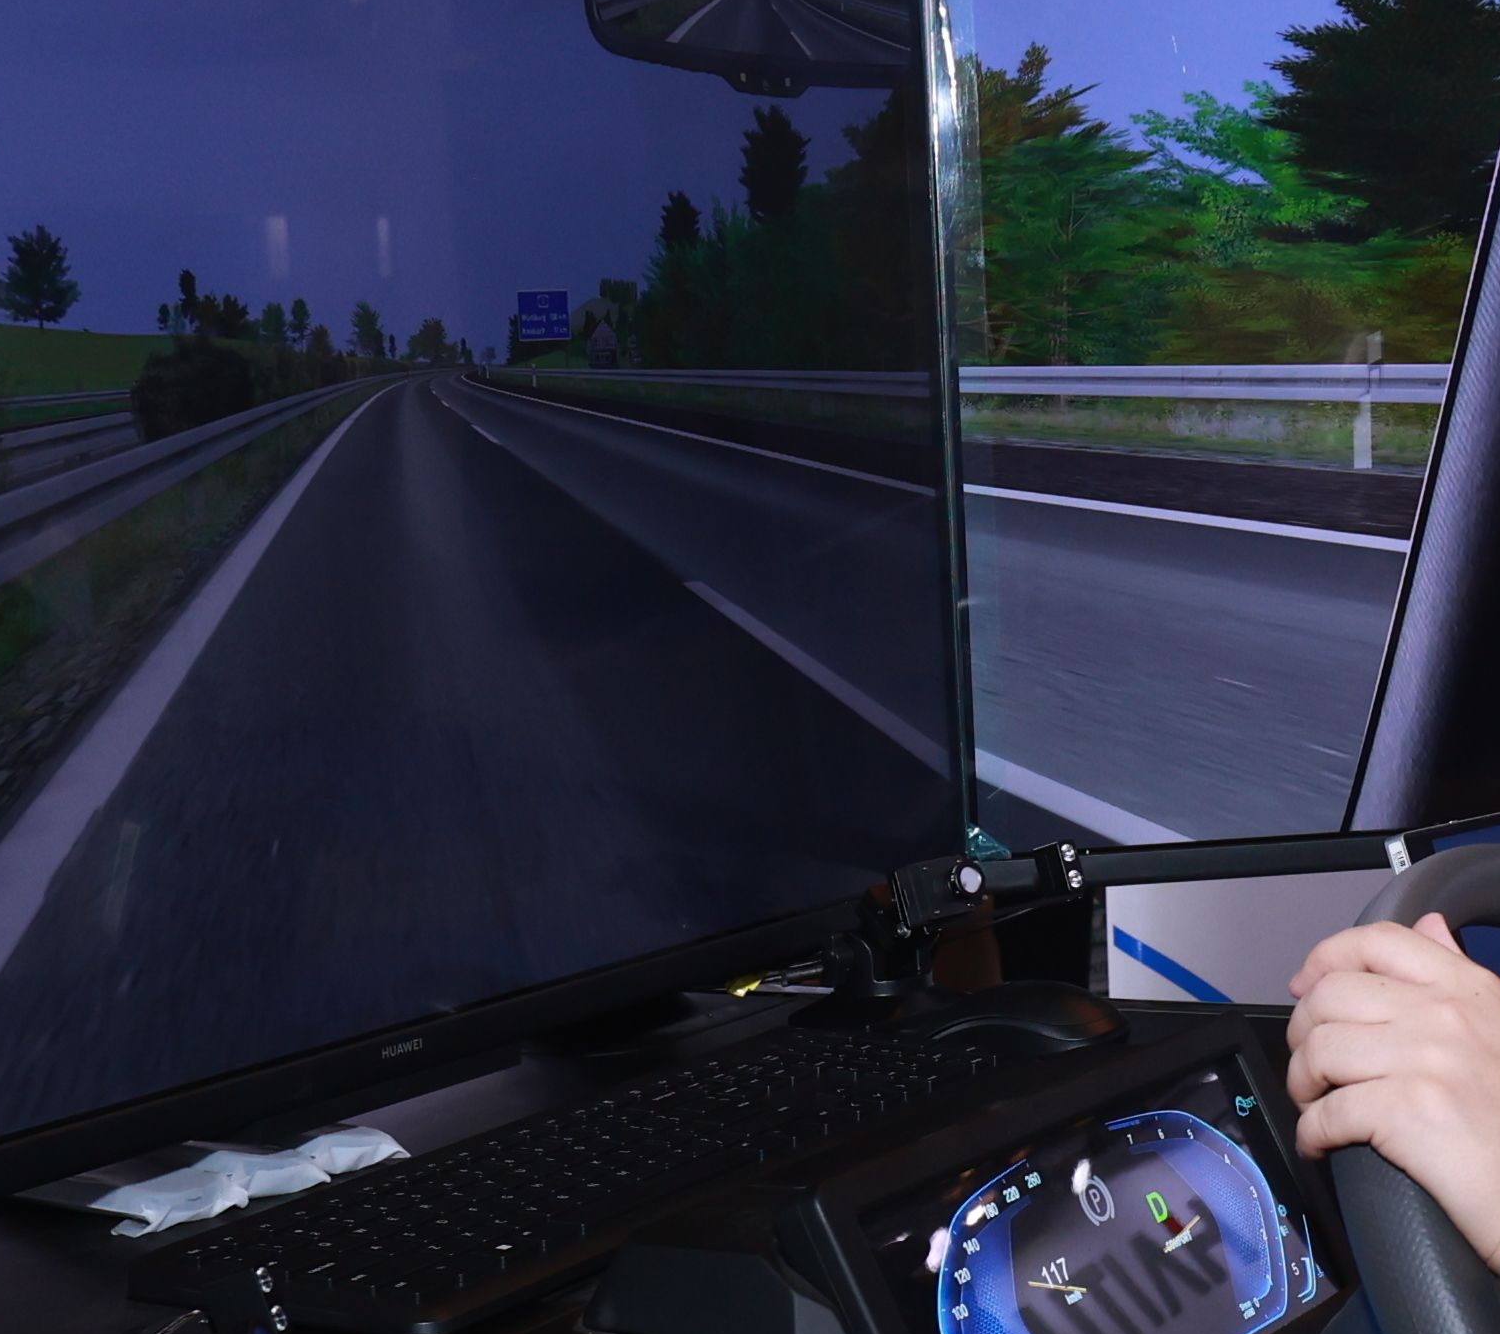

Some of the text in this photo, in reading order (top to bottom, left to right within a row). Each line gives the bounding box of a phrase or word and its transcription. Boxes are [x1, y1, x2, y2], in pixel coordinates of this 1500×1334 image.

[381, 1038, 423, 1059] HUAWEI
[1186, 1129, 1194, 1140] 5
[1223, 1153, 1231, 1165] 4
[1024, 1171, 1042, 1189] 260
[1003, 1185, 1020, 1203] 220
[1146, 1191, 1169, 1224] D
[962, 1237, 981, 1256] 140
[953, 1267, 972, 1286] 120
[1041, 1257, 1069, 1288] 117
[951, 1303, 970, 1321] 100
